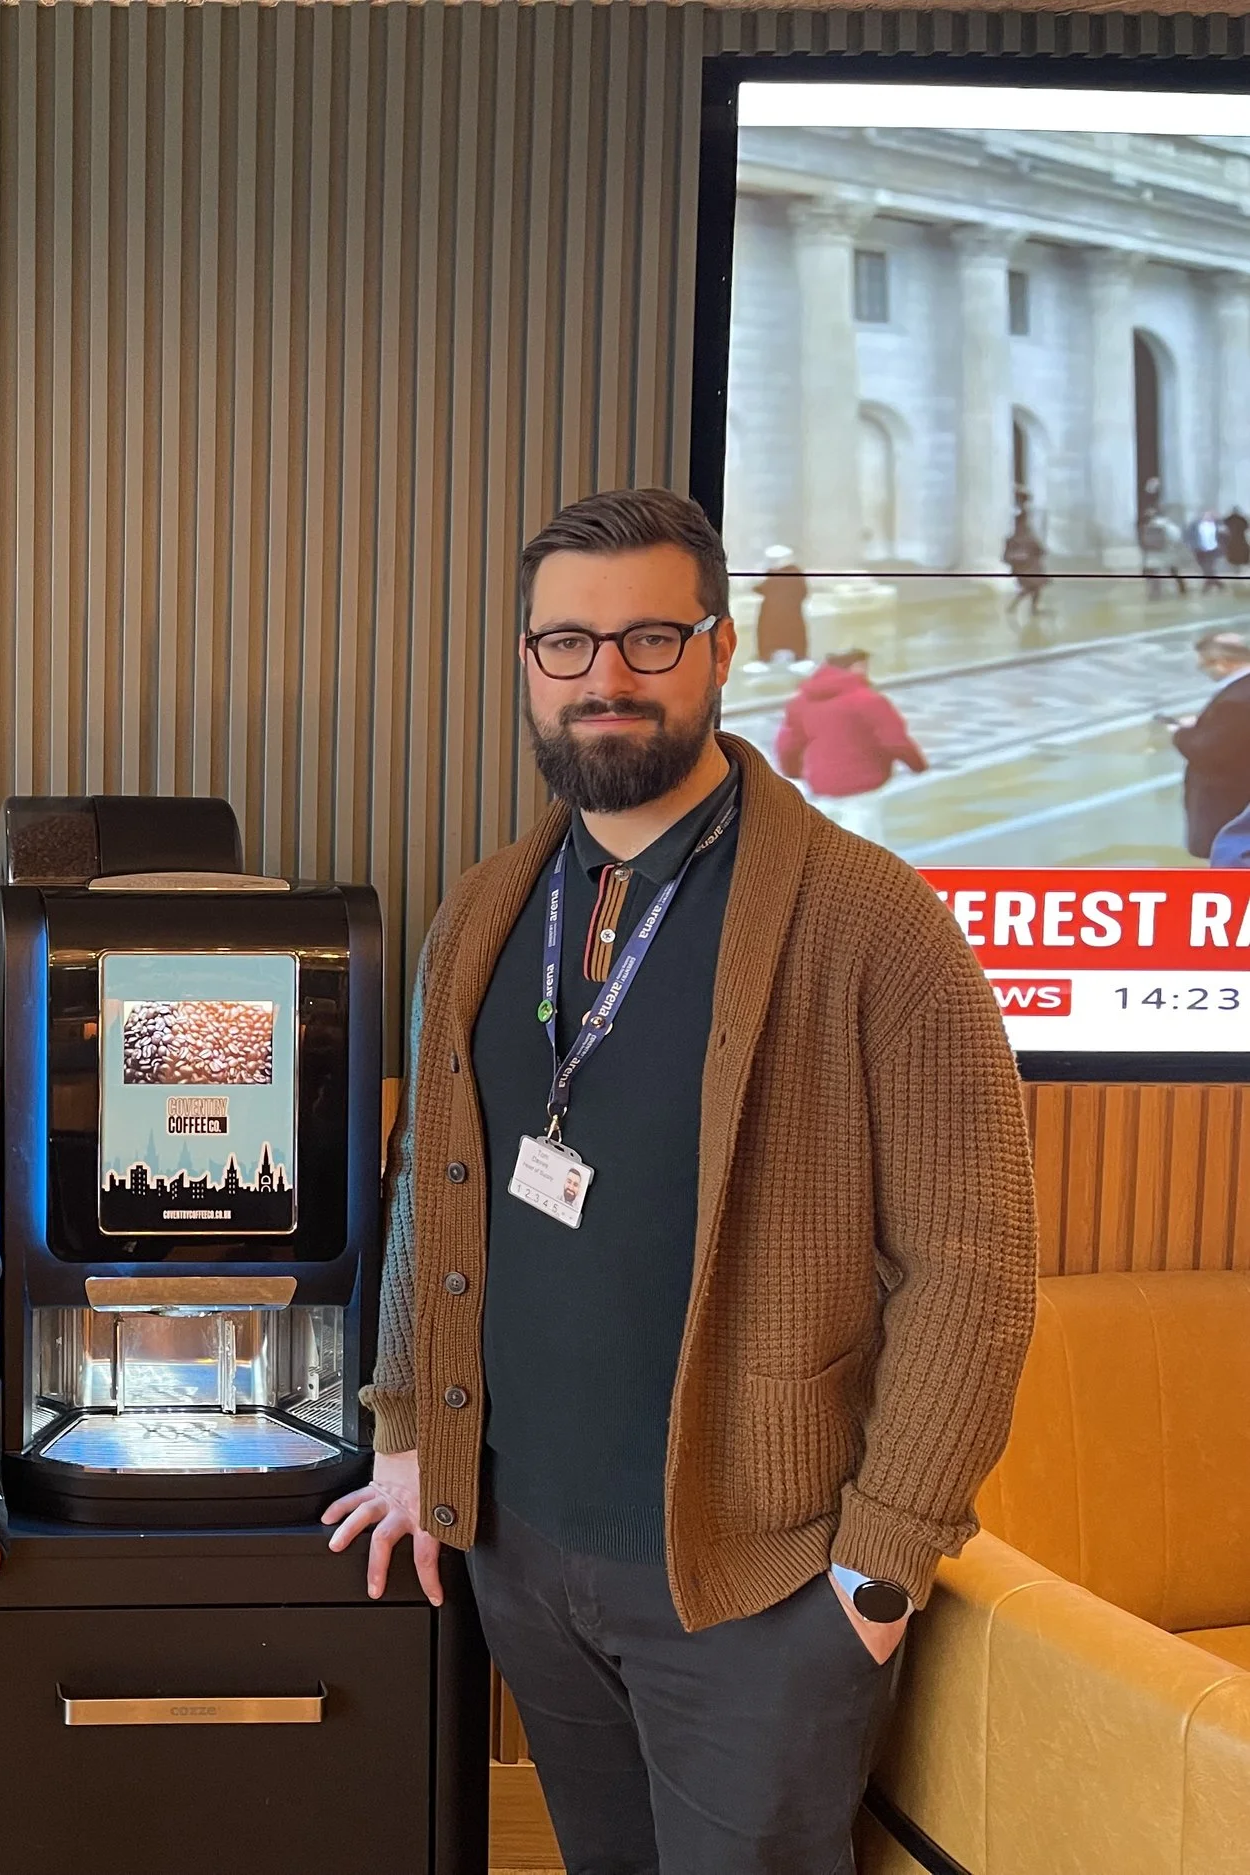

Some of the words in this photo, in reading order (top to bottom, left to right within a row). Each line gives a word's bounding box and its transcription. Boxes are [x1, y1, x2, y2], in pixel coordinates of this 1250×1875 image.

[550, 889, 559, 922] arena
[638, 904, 662, 939] arena
[936, 891, 1167, 947] EREST
[546, 964, 555, 997] arena
[598, 981, 623, 1017] arena
[1115, 987, 1240, 1010] 14:23
[558, 1057, 581, 1088] arena
[168, 1097, 228, 1116] COVENTRY
[168, 1116, 207, 1133] COFFEE
[208, 1119, 222, 1133] CO.
